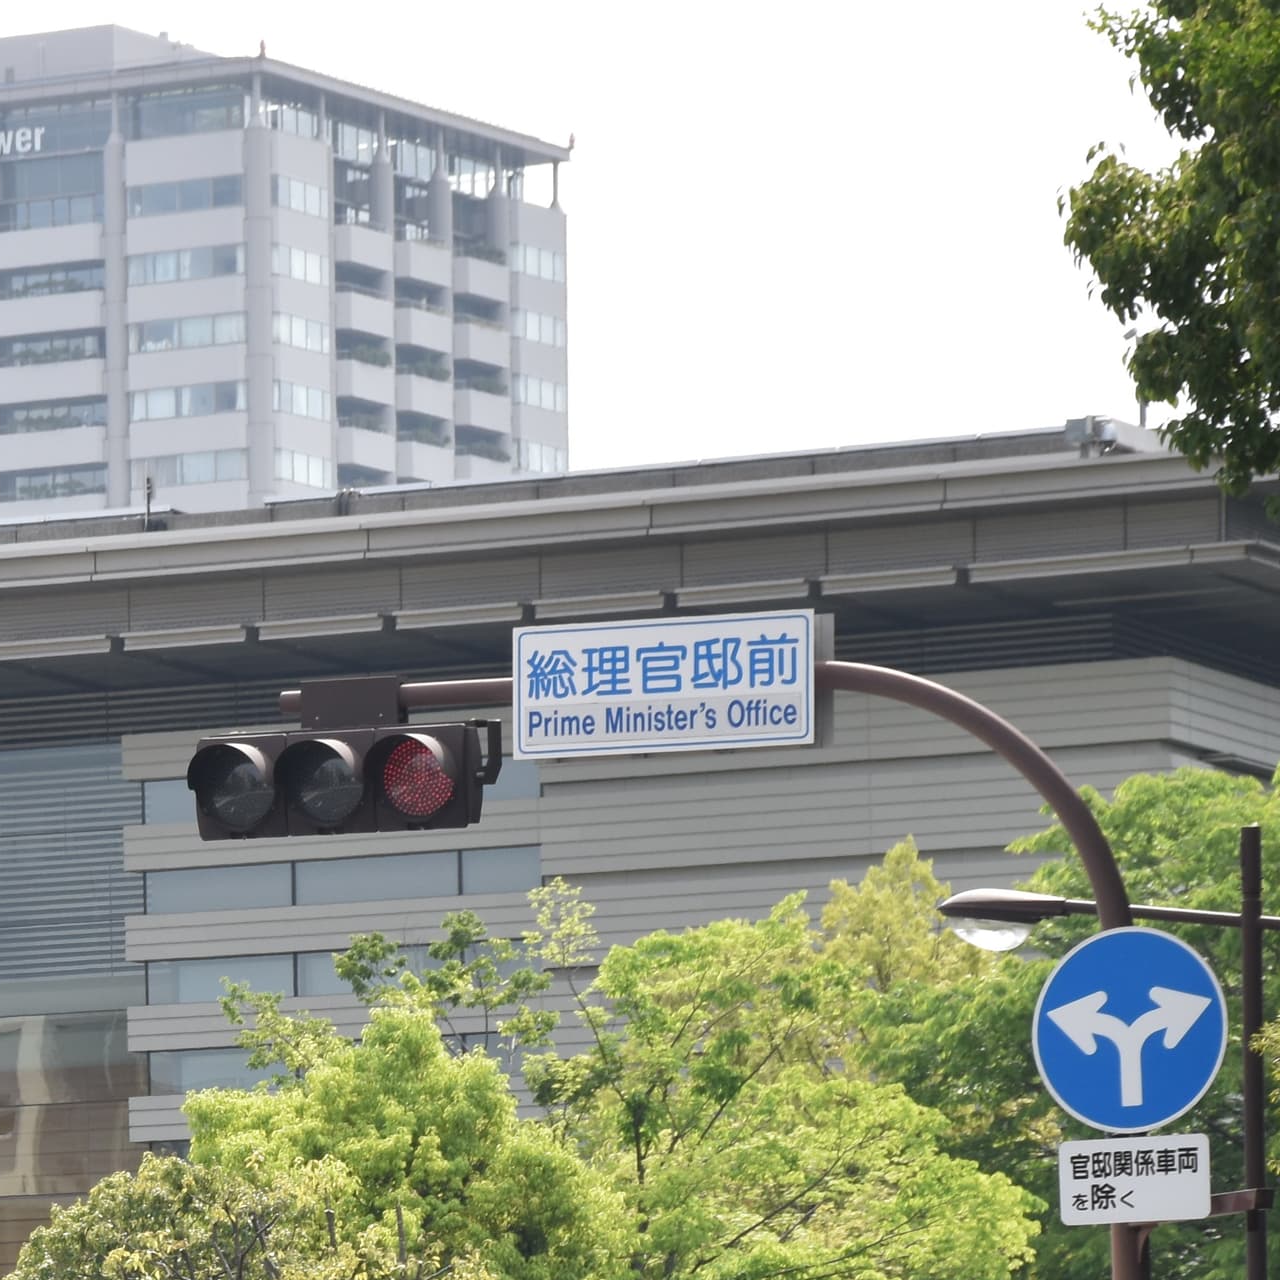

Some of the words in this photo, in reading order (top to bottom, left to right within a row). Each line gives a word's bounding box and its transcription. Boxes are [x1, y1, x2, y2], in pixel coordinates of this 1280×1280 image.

[526, 633, 800, 700] 総理官邸前
[528, 710, 595, 737] Prime
[605, 702, 717, 734] Minister's
[727, 700, 798, 728] Office
[1070, 1147, 1199, 1180] 官邸関係車両
[1072, 1184, 1135, 1210] を除く
